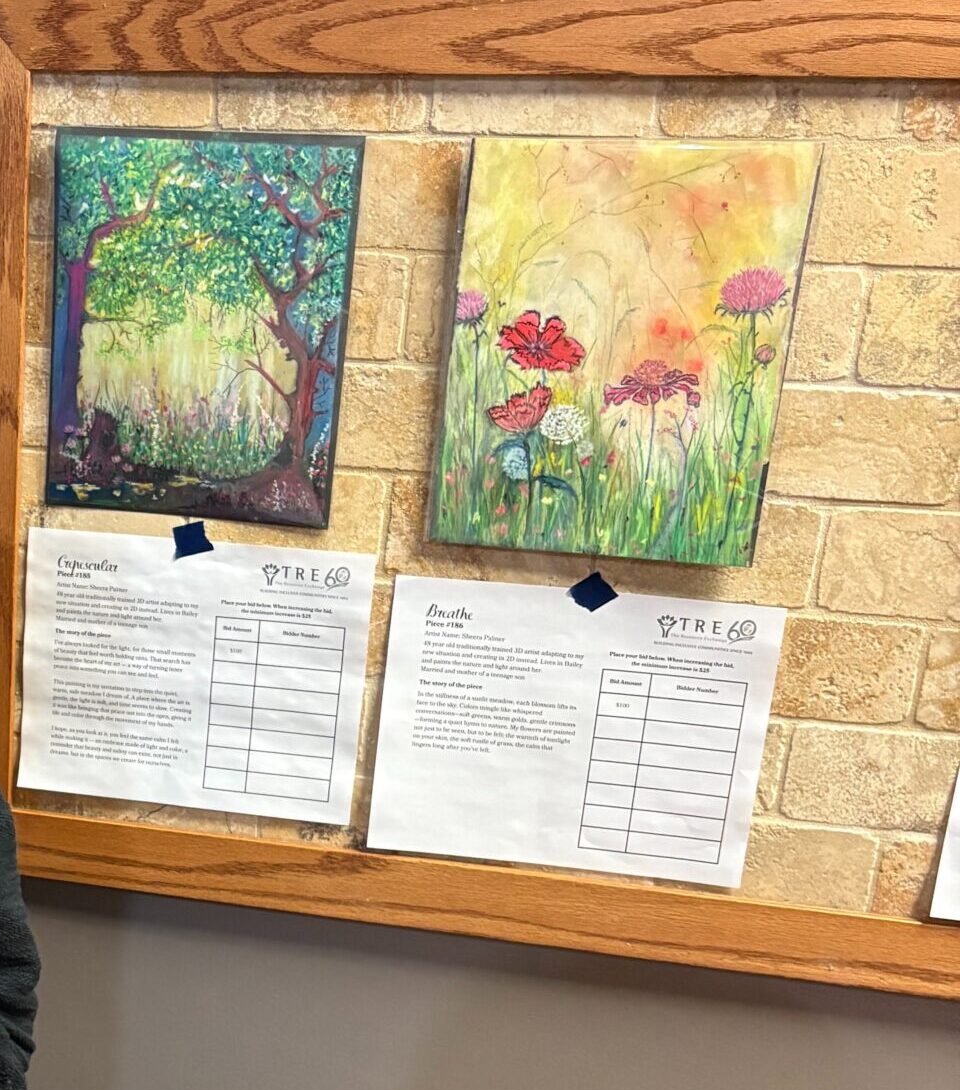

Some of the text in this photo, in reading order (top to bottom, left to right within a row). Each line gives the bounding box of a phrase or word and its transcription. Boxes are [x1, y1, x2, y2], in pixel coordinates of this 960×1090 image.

[281, 566, 319, 582] TRE
[426, 603, 473, 620] Breathe
[679, 617, 722, 635] TRE
[684, 659, 713, 667] increasing
